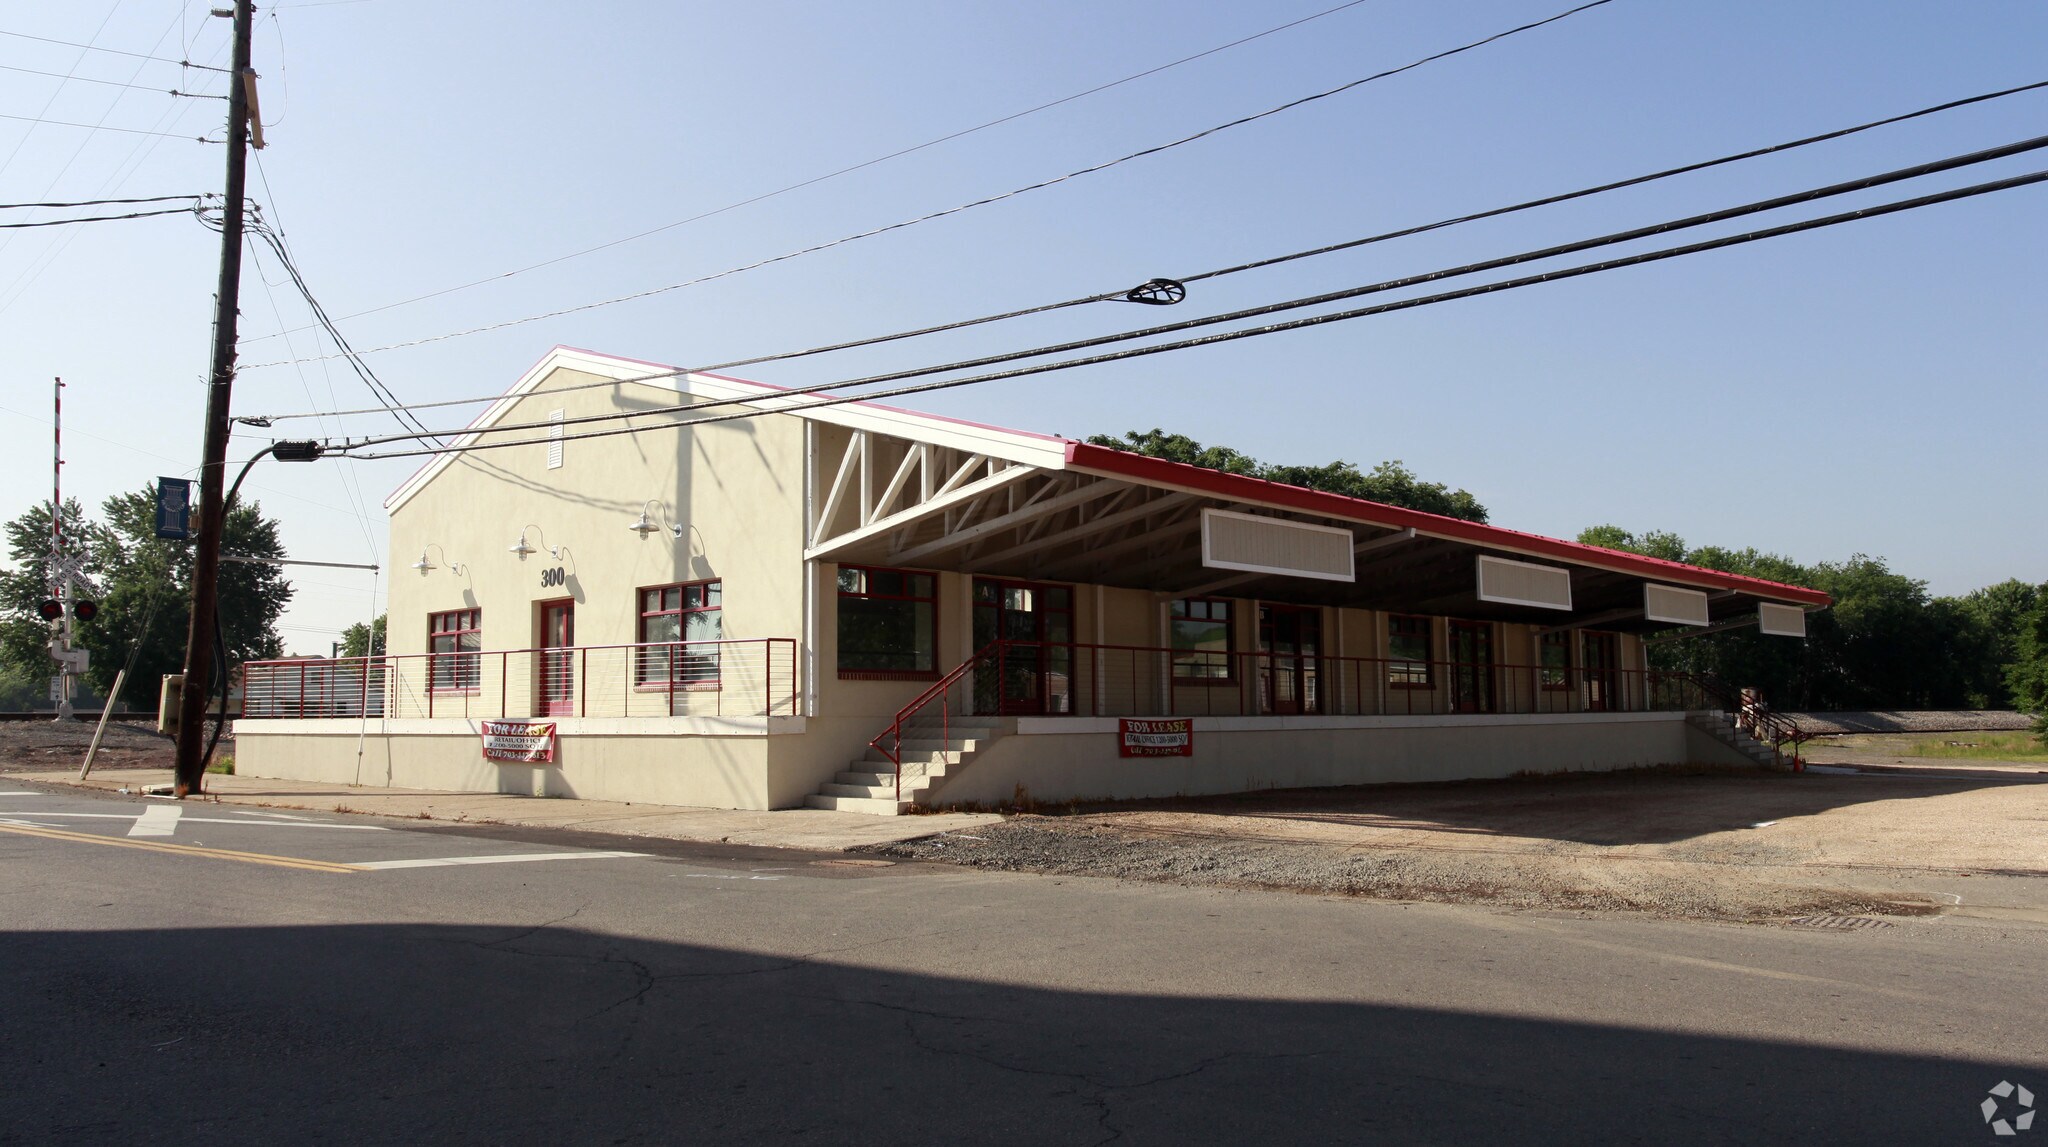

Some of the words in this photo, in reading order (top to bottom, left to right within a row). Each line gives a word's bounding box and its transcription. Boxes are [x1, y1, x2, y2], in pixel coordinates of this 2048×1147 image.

[50, 554, 89, 587] CROSSING
[541, 566, 565, 588] 300
[982, 585, 989, 597] A
[487, 723, 509, 735] FOR
[511, 724, 548, 736] LEASE
[1126, 721, 1150, 733] FOR
[1152, 721, 1187, 733] LEASE
[486, 749, 502, 757] Call
